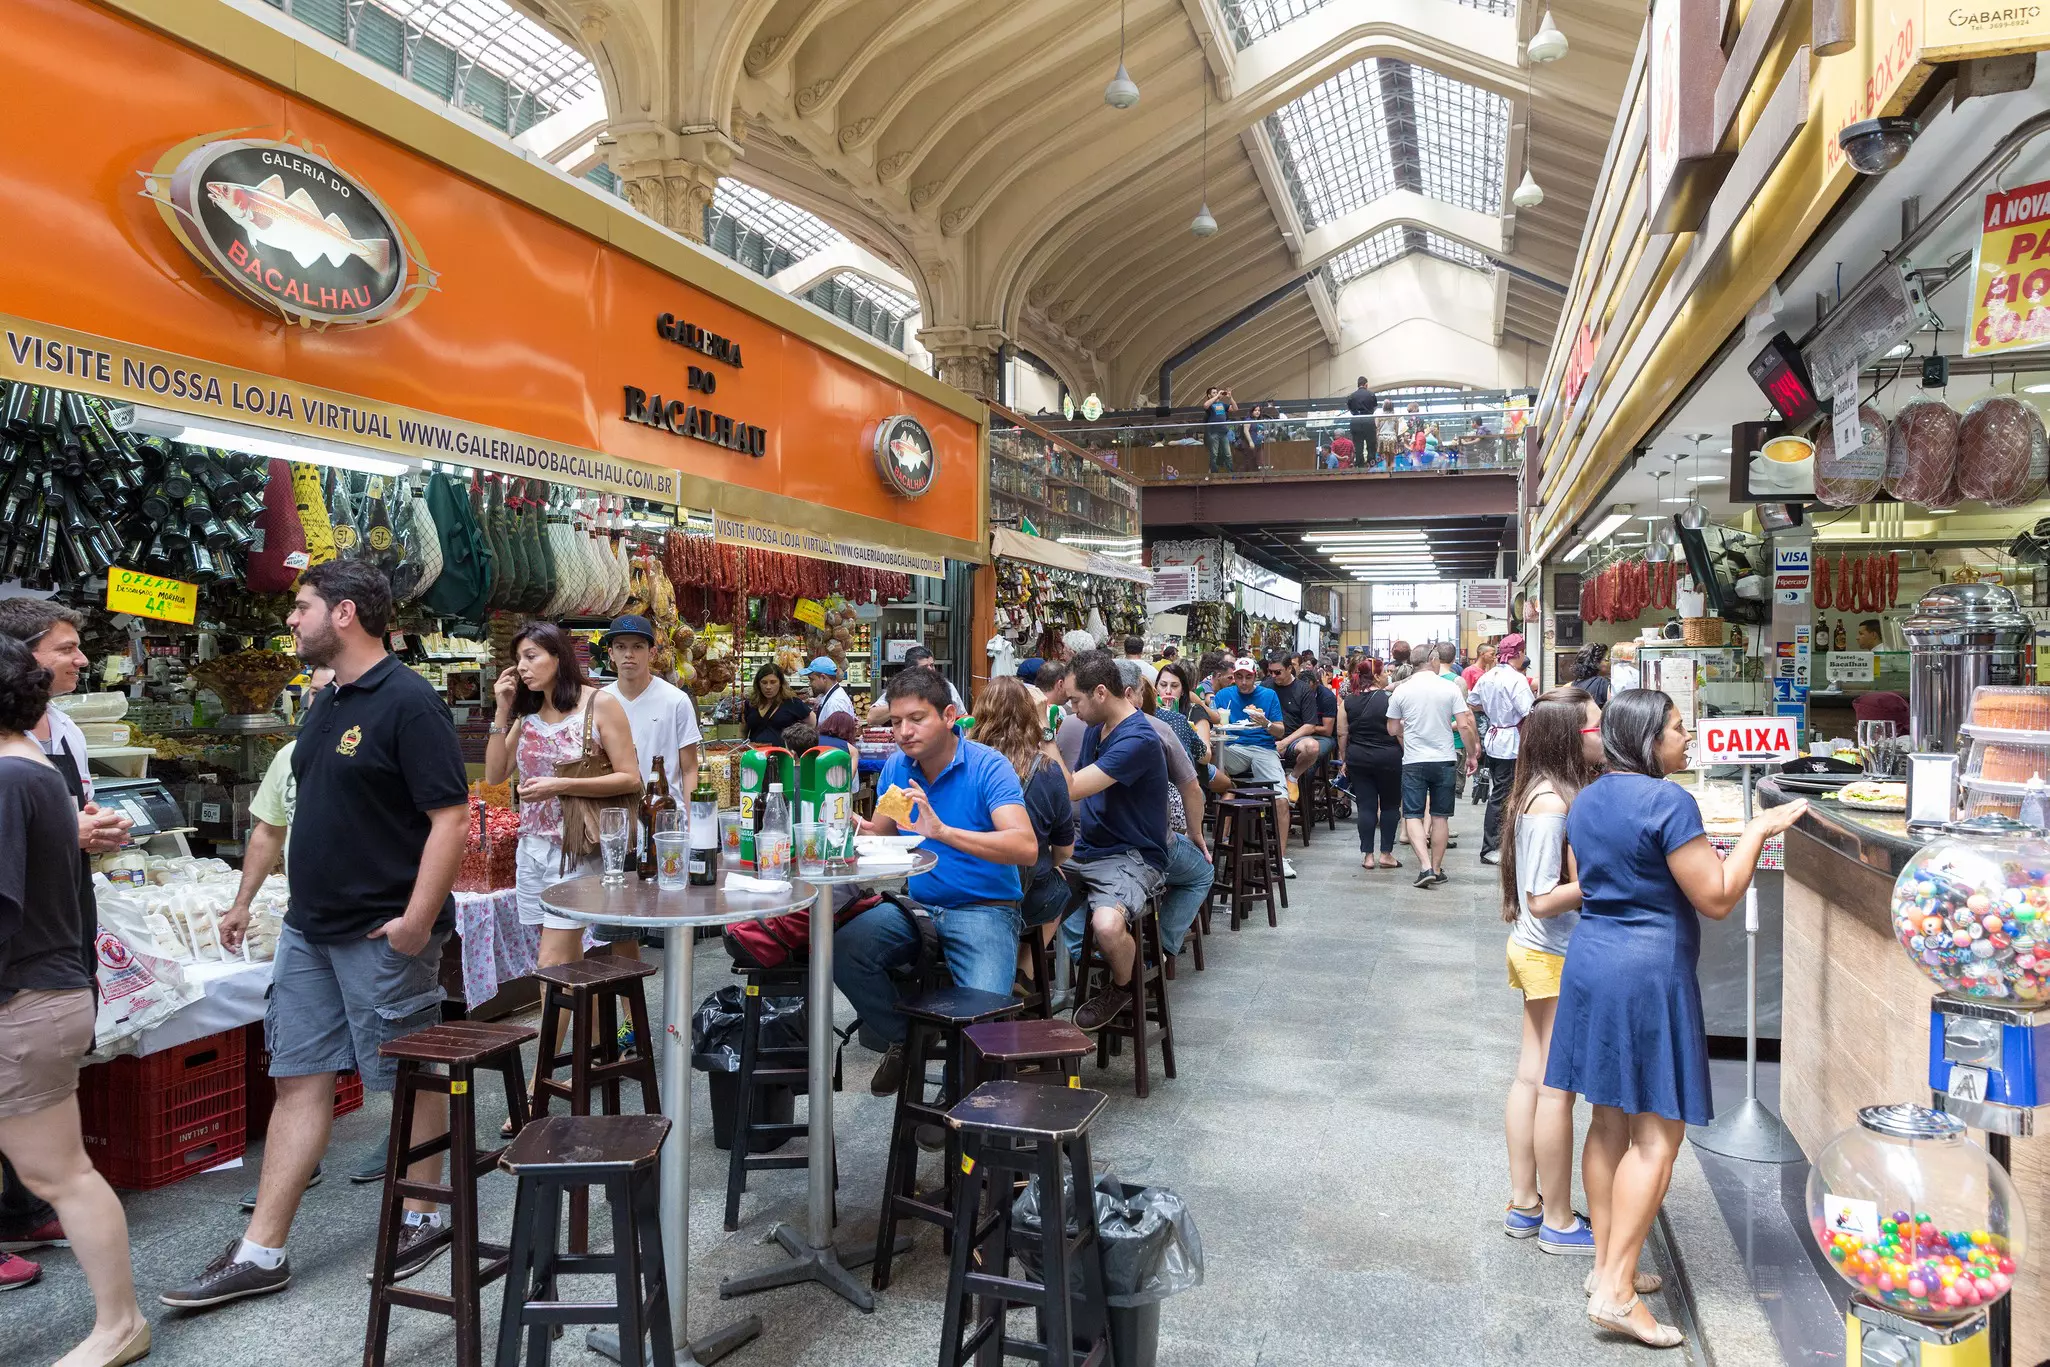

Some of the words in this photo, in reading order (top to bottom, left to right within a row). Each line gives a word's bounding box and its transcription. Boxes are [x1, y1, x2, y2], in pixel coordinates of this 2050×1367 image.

[1948, 6, 2041, 27] GABARITO
[1865, 44, 1894, 117] BOX
[1897, 18, 1913, 73] 20
[262, 151, 326, 184] GALERIA
[330, 177, 350, 198] DO
[1988, 203, 2001, 228] A
[2004, 191, 2050, 224] NOVA
[227, 239, 372, 310] BACALHAU
[656, 312, 744, 369] GALERIA
[687, 365, 716, 394] DO
[6, 330, 111, 383] VISITE
[122, 356, 223, 406] NOSSA
[231, 381, 294, 420] LOJA
[300, 396, 392, 440] VIRTUAL
[398, 418, 673, 495] WWW.GALERIADOBACALHAU.COM.BR
[623, 385, 767, 458] BACALHAU
[901, 421, 916, 430] GALERIA
[894, 465, 927, 490] BACALHAU
[716, 518, 745, 540] VISITE
[747, 526, 778, 545] NOSSA
[780, 534, 800, 549] LOJA
[802, 536, 833, 555] VIRTUAL
[1781, 551, 1808, 562] VISA
[121, 572, 180, 592] OFERTA
[1778, 578, 1807, 587] Hipercard
[1707, 728, 1791, 752] CAIXA
[741, 796, 753, 818] 2
[834, 797, 844, 819] 1
[179, 1127, 208, 1142] CALLANI
